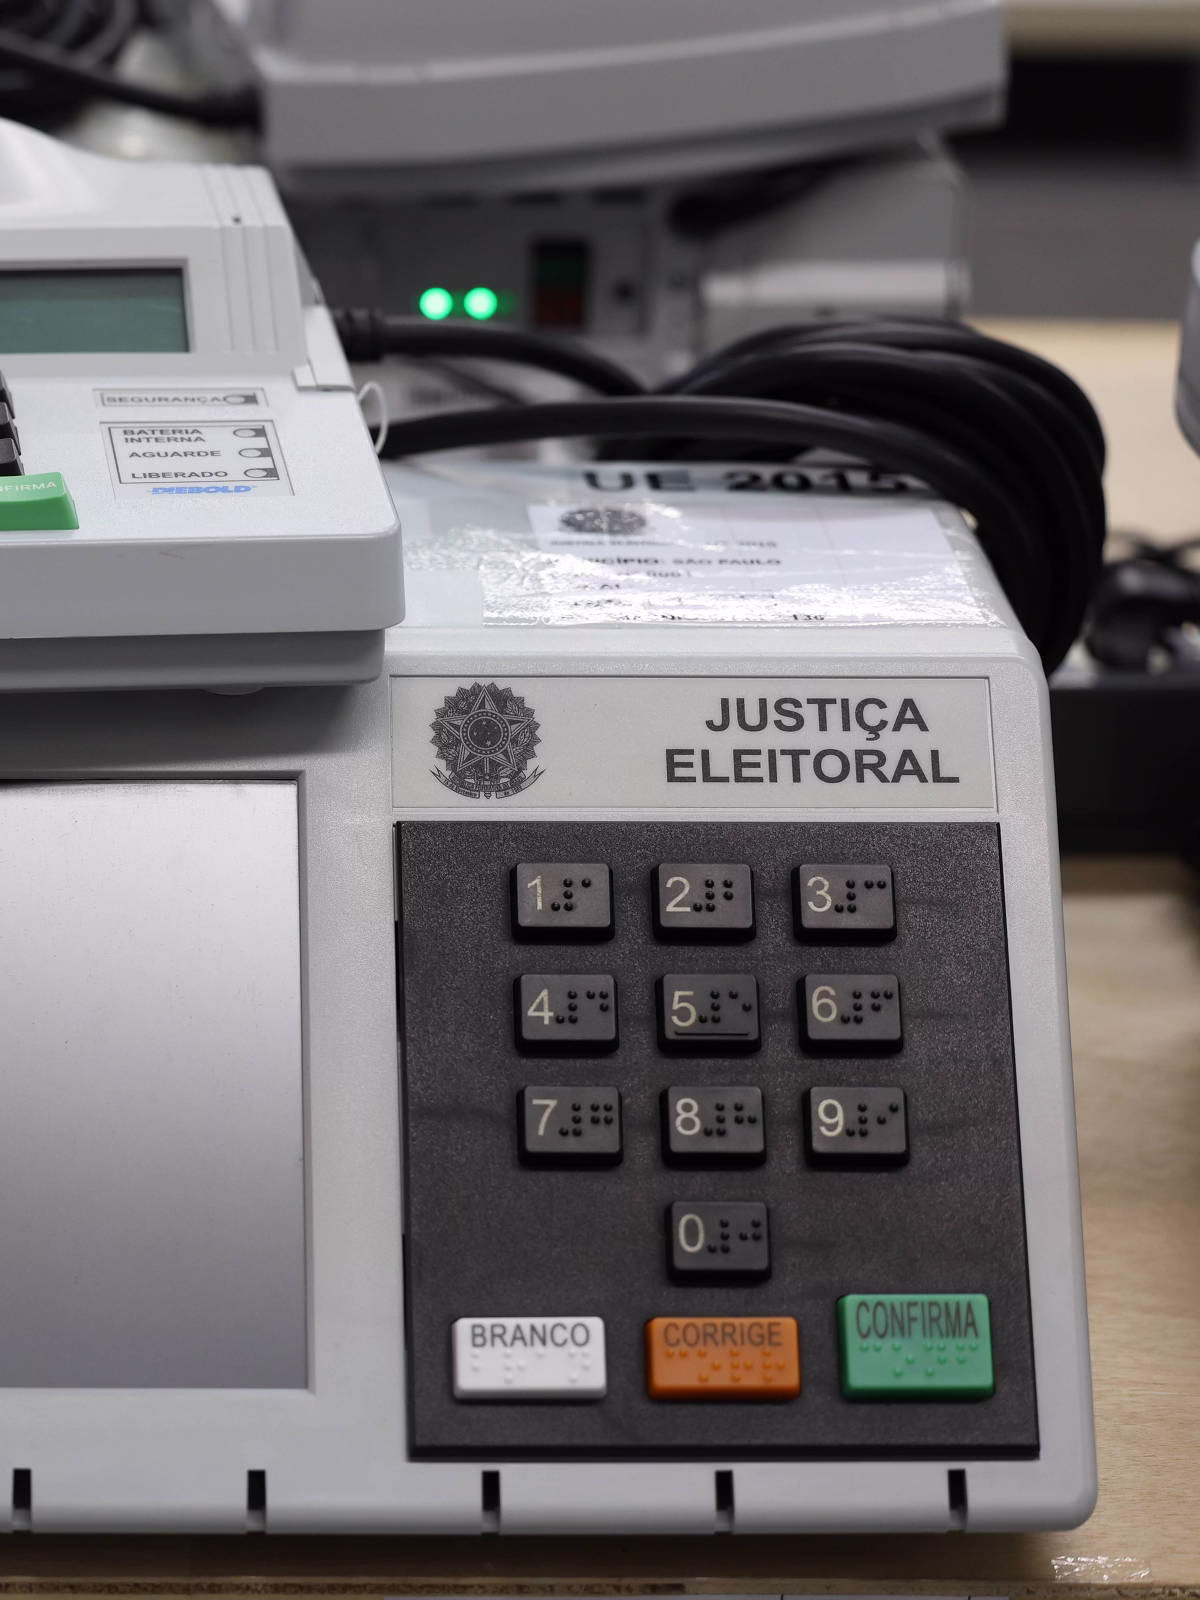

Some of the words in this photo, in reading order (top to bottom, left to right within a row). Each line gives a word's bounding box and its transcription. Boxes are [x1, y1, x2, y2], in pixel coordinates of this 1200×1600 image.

[106, 395, 226, 405] SEGURANÇA
[123, 428, 203, 436] BATERIA
[125, 436, 206, 444] INTERNA
[129, 449, 221, 458] AGUARDE
[132, 470, 228, 479] LIBERADO
[584, 470, 695, 493] UE
[725, 469, 911, 493] 2015
[149, 485, 253, 495] DIEBOLD
[718, 557, 781, 566] PAULO
[705, 696, 930, 741] JUSTIÇA
[665, 748, 960, 785] ELEITORAL
[526, 875, 543, 911] 1
[664, 876, 692, 914] 2
[806, 876, 833, 913] 3
[526, 988, 554, 1025] 4
[670, 990, 697, 1028] 5
[811, 985, 839, 1023] 6
[531, 1099, 558, 1136] 7
[675, 1098, 702, 1136] 8
[817, 1099, 845, 1137] 9
[677, 1213, 705, 1253] 0
[855, 1300, 980, 1340] CONFIRMA
[470, 1322, 591, 1349] BRANCO
[663, 1321, 783, 1349] CORRIGE
